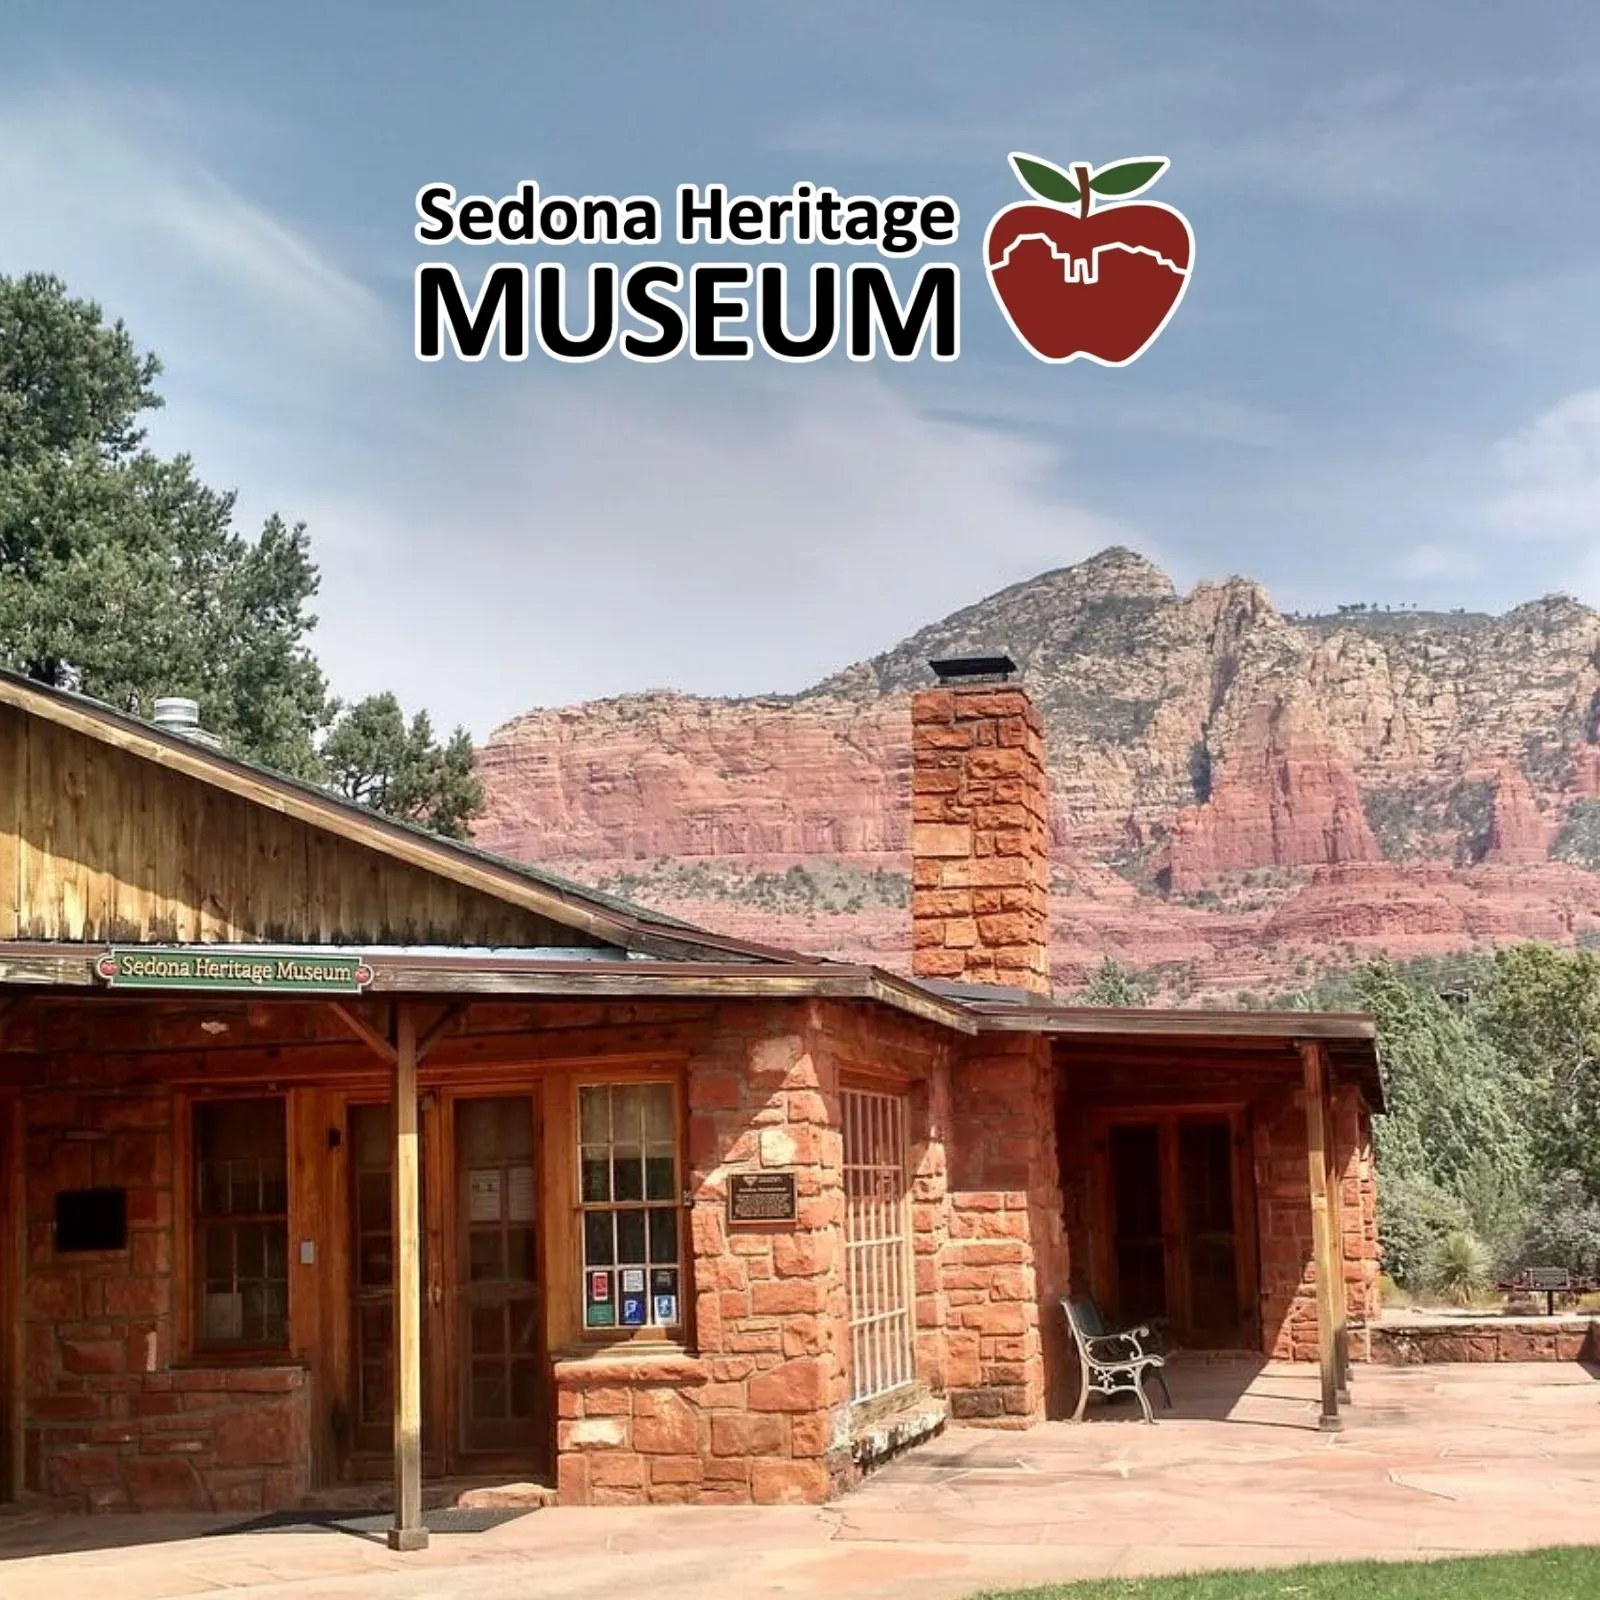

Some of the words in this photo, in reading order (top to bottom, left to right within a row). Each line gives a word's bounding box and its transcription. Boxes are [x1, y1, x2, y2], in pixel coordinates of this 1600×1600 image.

[121, 956, 190, 977] Sedona
[195, 958, 272, 984] Heritage
[276, 961, 351, 981] Museum
